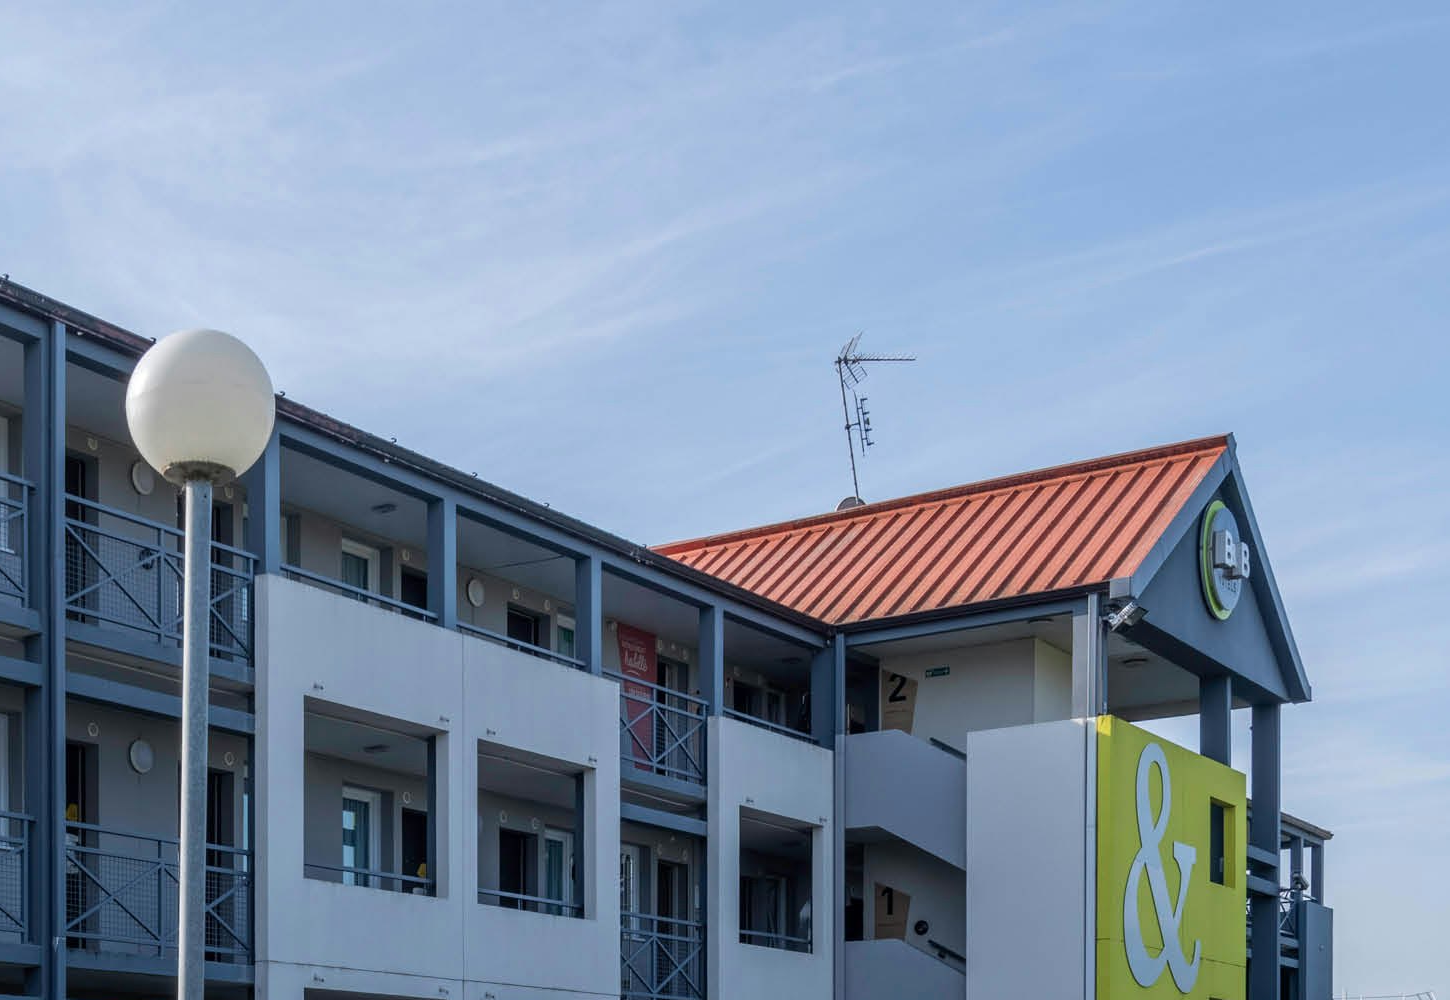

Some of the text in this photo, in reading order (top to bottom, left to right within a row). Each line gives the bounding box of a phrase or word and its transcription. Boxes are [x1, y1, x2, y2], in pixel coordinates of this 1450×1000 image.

[1218, 529, 1250, 579] BB
[888, 673, 907, 703] 2
[1123, 743, 1201, 994] &
[881, 886, 893, 915] 1
